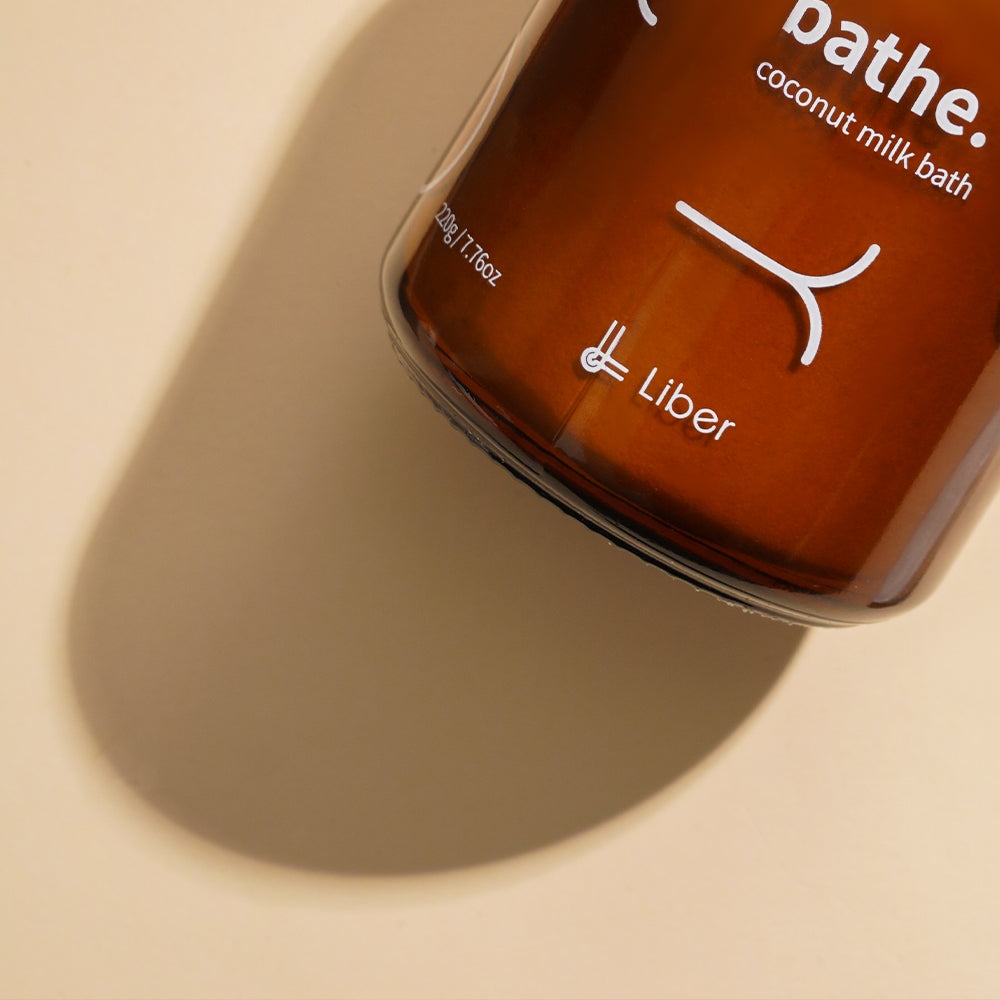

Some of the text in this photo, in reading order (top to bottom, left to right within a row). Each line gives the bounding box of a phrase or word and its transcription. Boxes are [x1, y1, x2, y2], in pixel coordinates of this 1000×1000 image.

[756, 61, 973, 200] coconut milk bath
[638, 367, 736, 440] Liber
